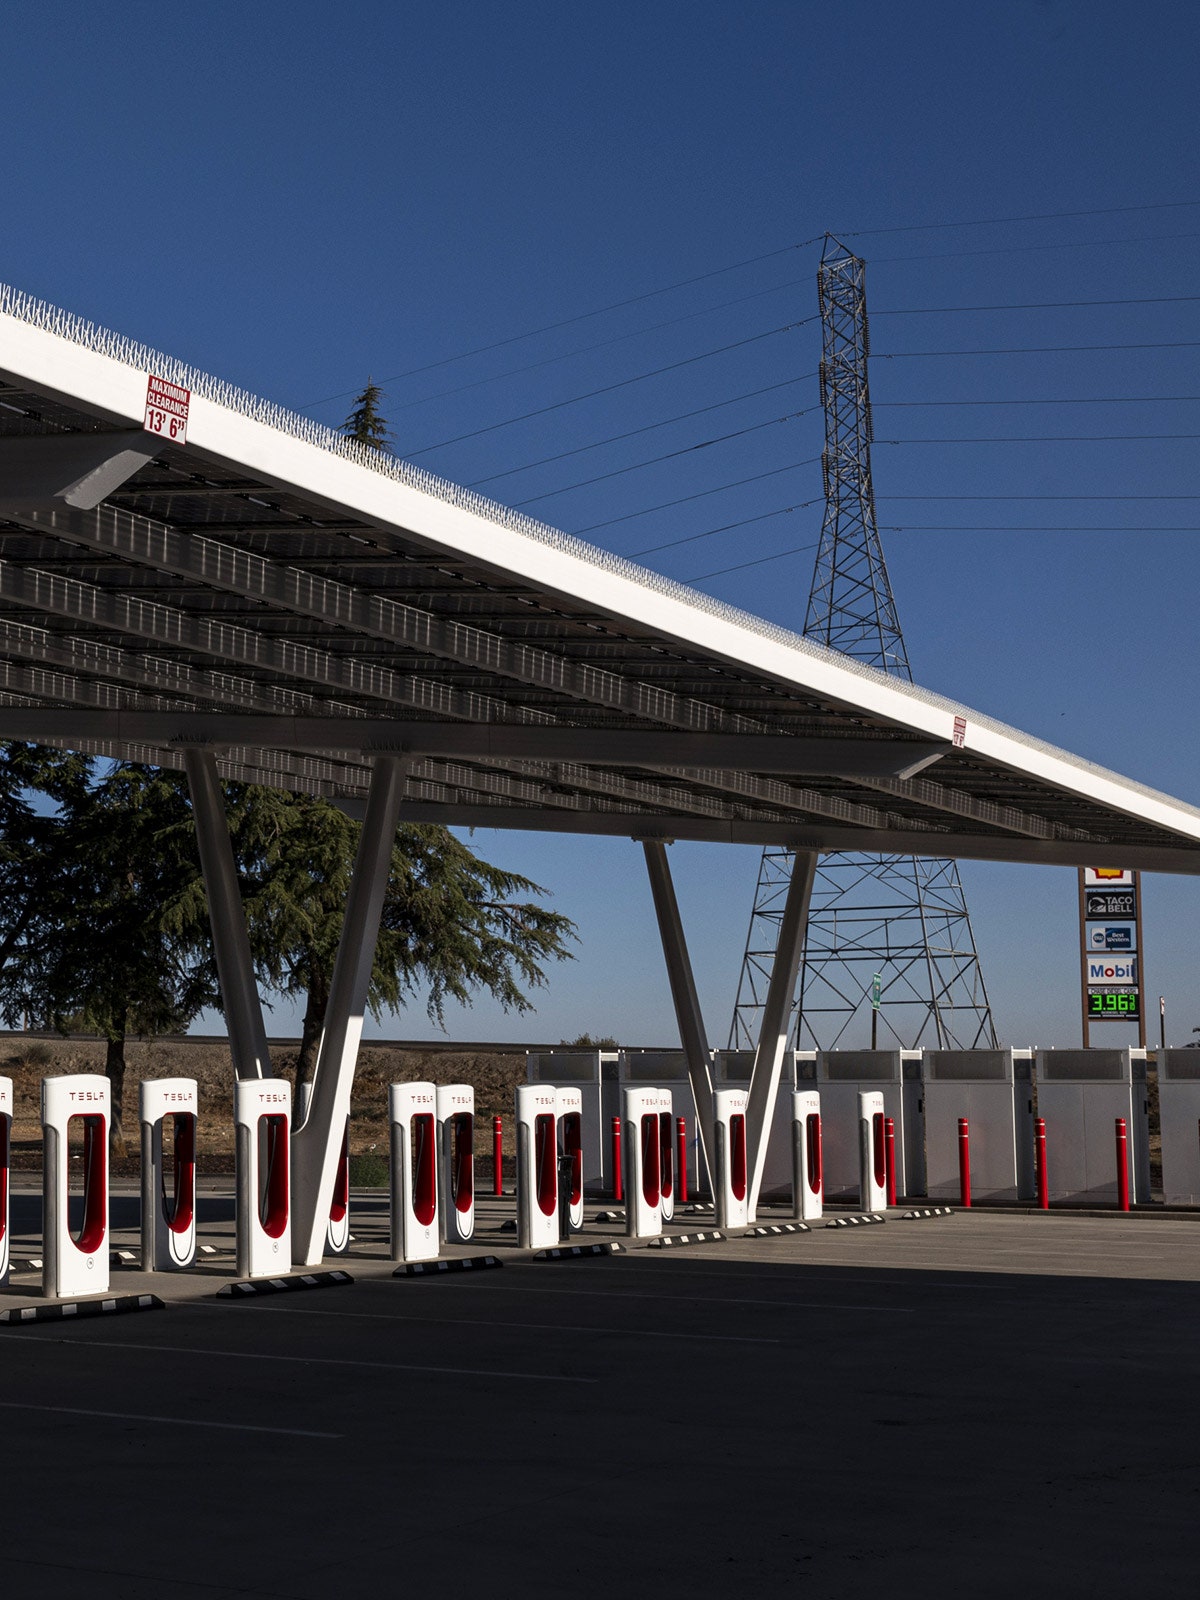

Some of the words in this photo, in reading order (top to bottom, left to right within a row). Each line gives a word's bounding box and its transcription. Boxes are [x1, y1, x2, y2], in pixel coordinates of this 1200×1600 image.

[151, 379, 187, 403] MAXIMUM
[148, 391, 188, 418] CLEARANCE
[1106, 896, 1133, 905] TACO
[1107, 904, 1133, 913] BELL
[1090, 964, 1135, 978] Mobil
[69, 1092, 105, 1101] TESLA
[163, 1093, 193, 1101] TESLA
[259, 1094, 287, 1102] TESLA
[411, 1095, 433, 1103] TESLA
[451, 1096, 472, 1104] TESLA
[535, 1097, 555, 1105] TESLA
